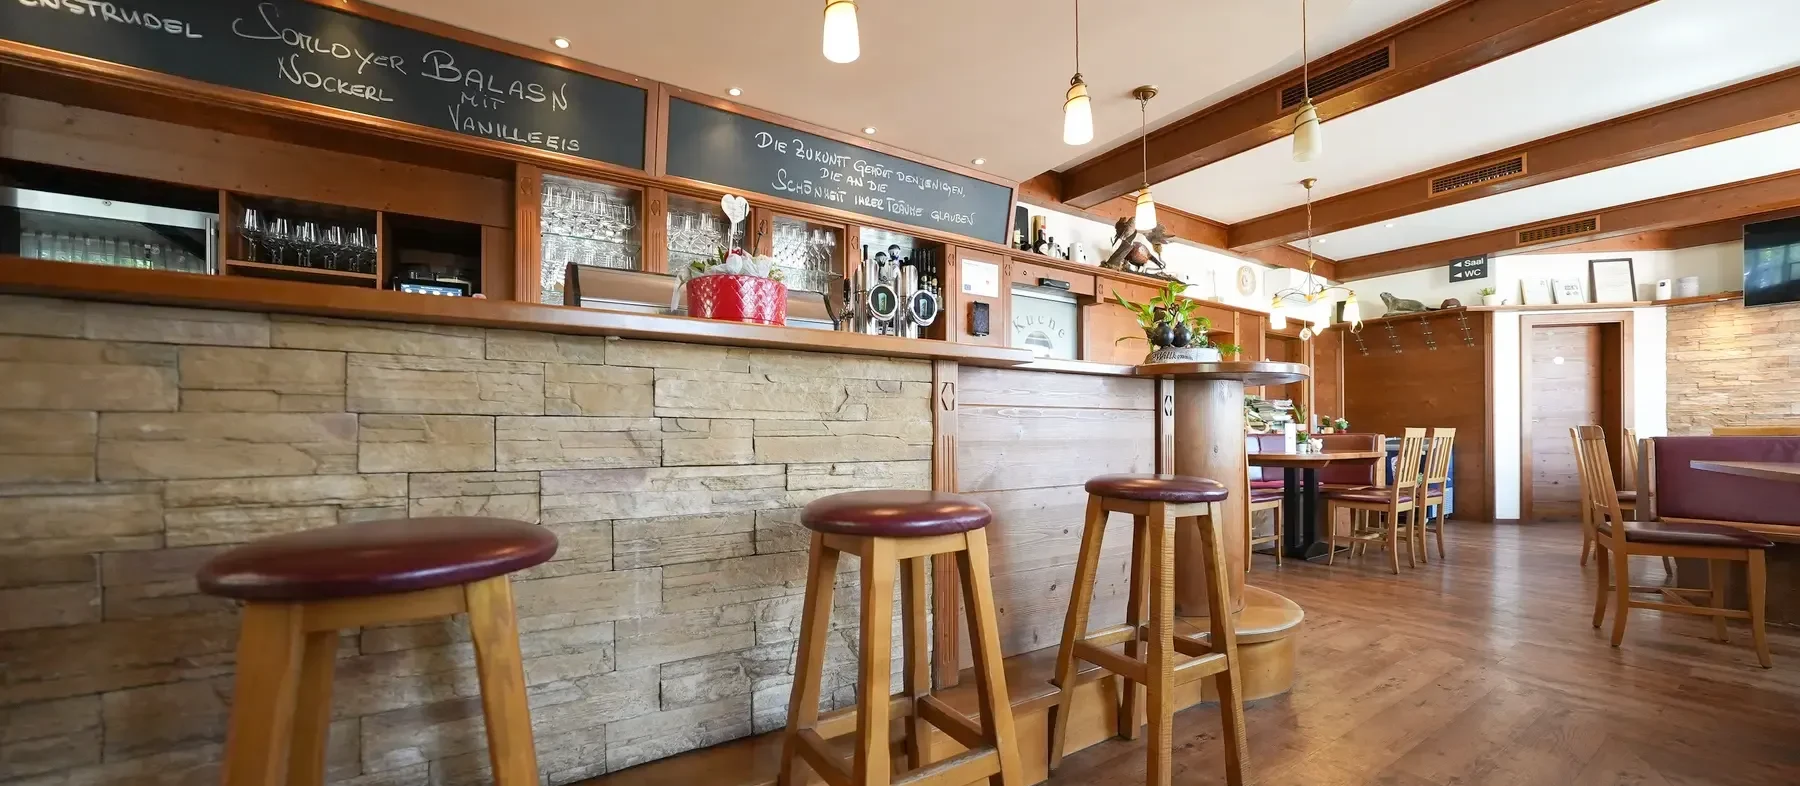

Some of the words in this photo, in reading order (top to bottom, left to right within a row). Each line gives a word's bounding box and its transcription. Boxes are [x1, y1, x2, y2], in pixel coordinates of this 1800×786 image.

[277, 53, 394, 102] NOCKERL
[421, 50, 567, 112] BALASN
[819, 167, 843, 182] DIE
[846, 175, 864, 187] AN
[867, 180, 888, 193] DIE
[1464, 257, 1484, 267] Saal
[1464, 268, 1481, 278] WC
